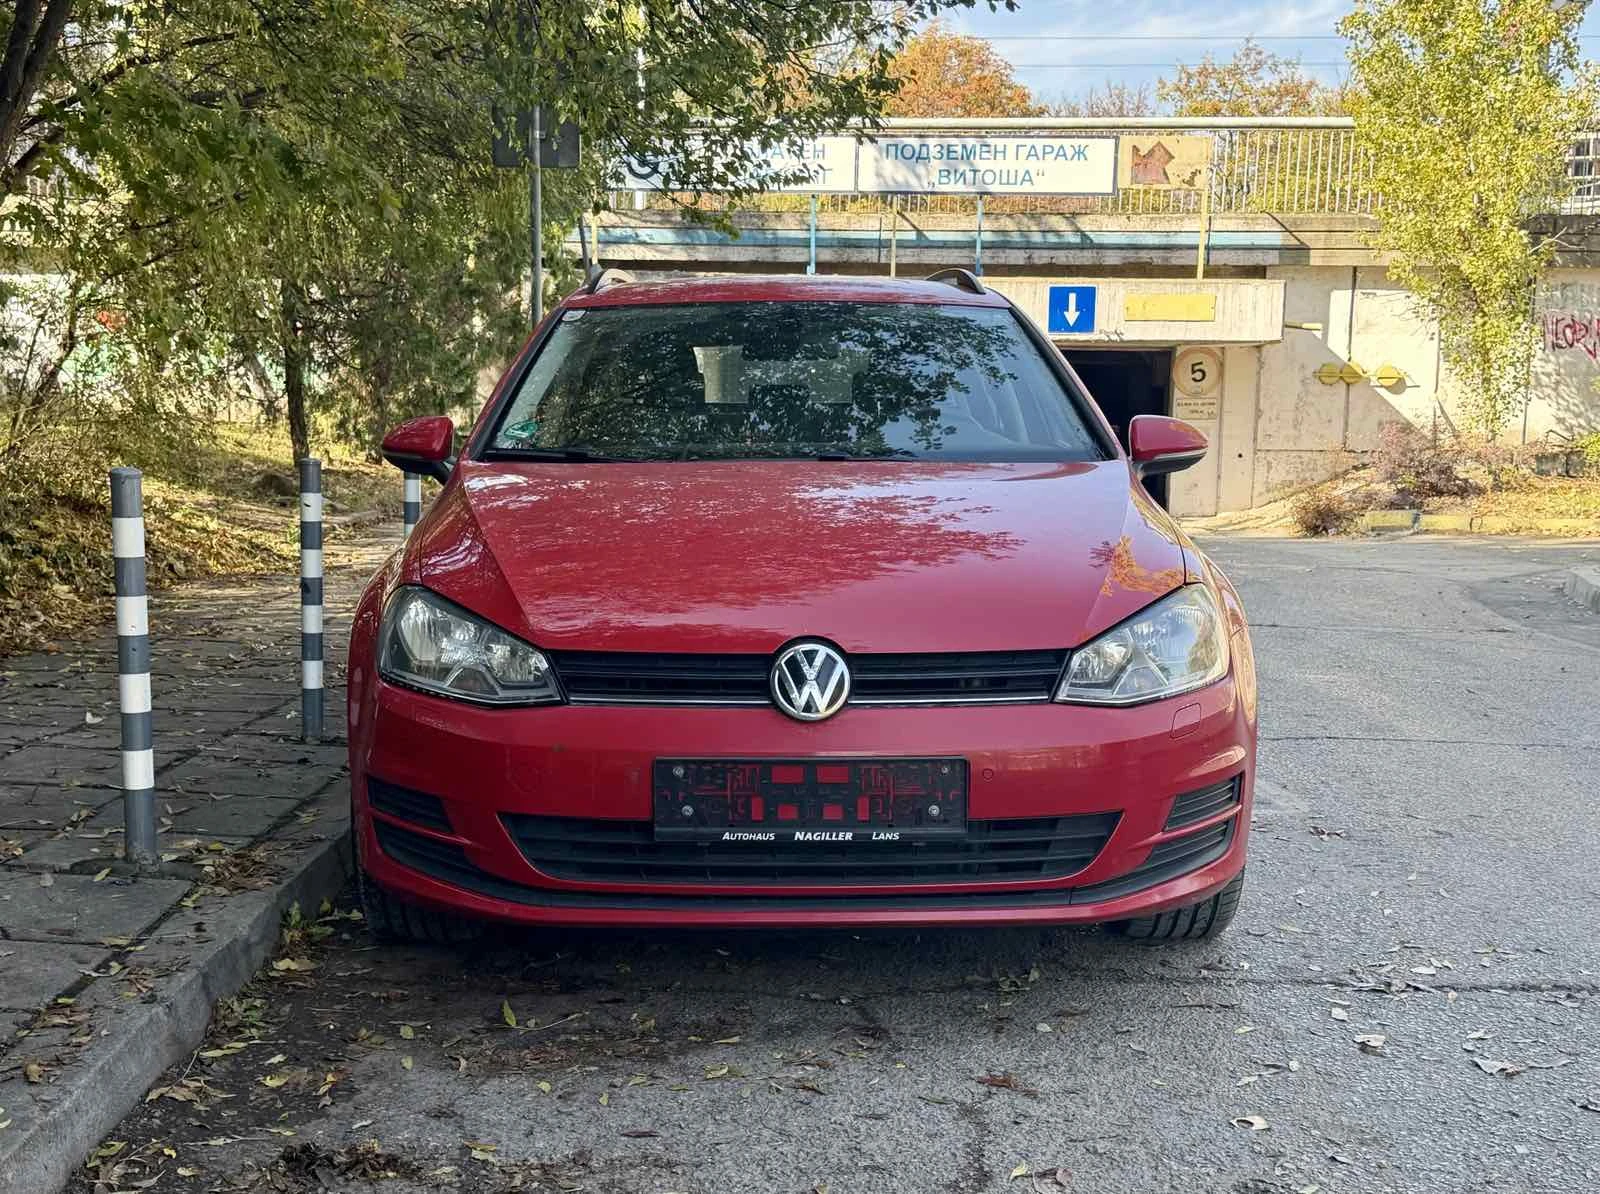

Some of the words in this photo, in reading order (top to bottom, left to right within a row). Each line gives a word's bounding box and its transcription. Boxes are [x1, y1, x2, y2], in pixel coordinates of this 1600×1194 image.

[885, 143, 1007, 163] ПОДЗЕМЕН
[1015, 143, 1089, 161] ГАРАЖ
[1190, 361, 1207, 383] 5
[722, 831, 776, 841] AUTOHAUS
[794, 831, 853, 841] NAGILLER
[871, 831, 900, 841] LANS
